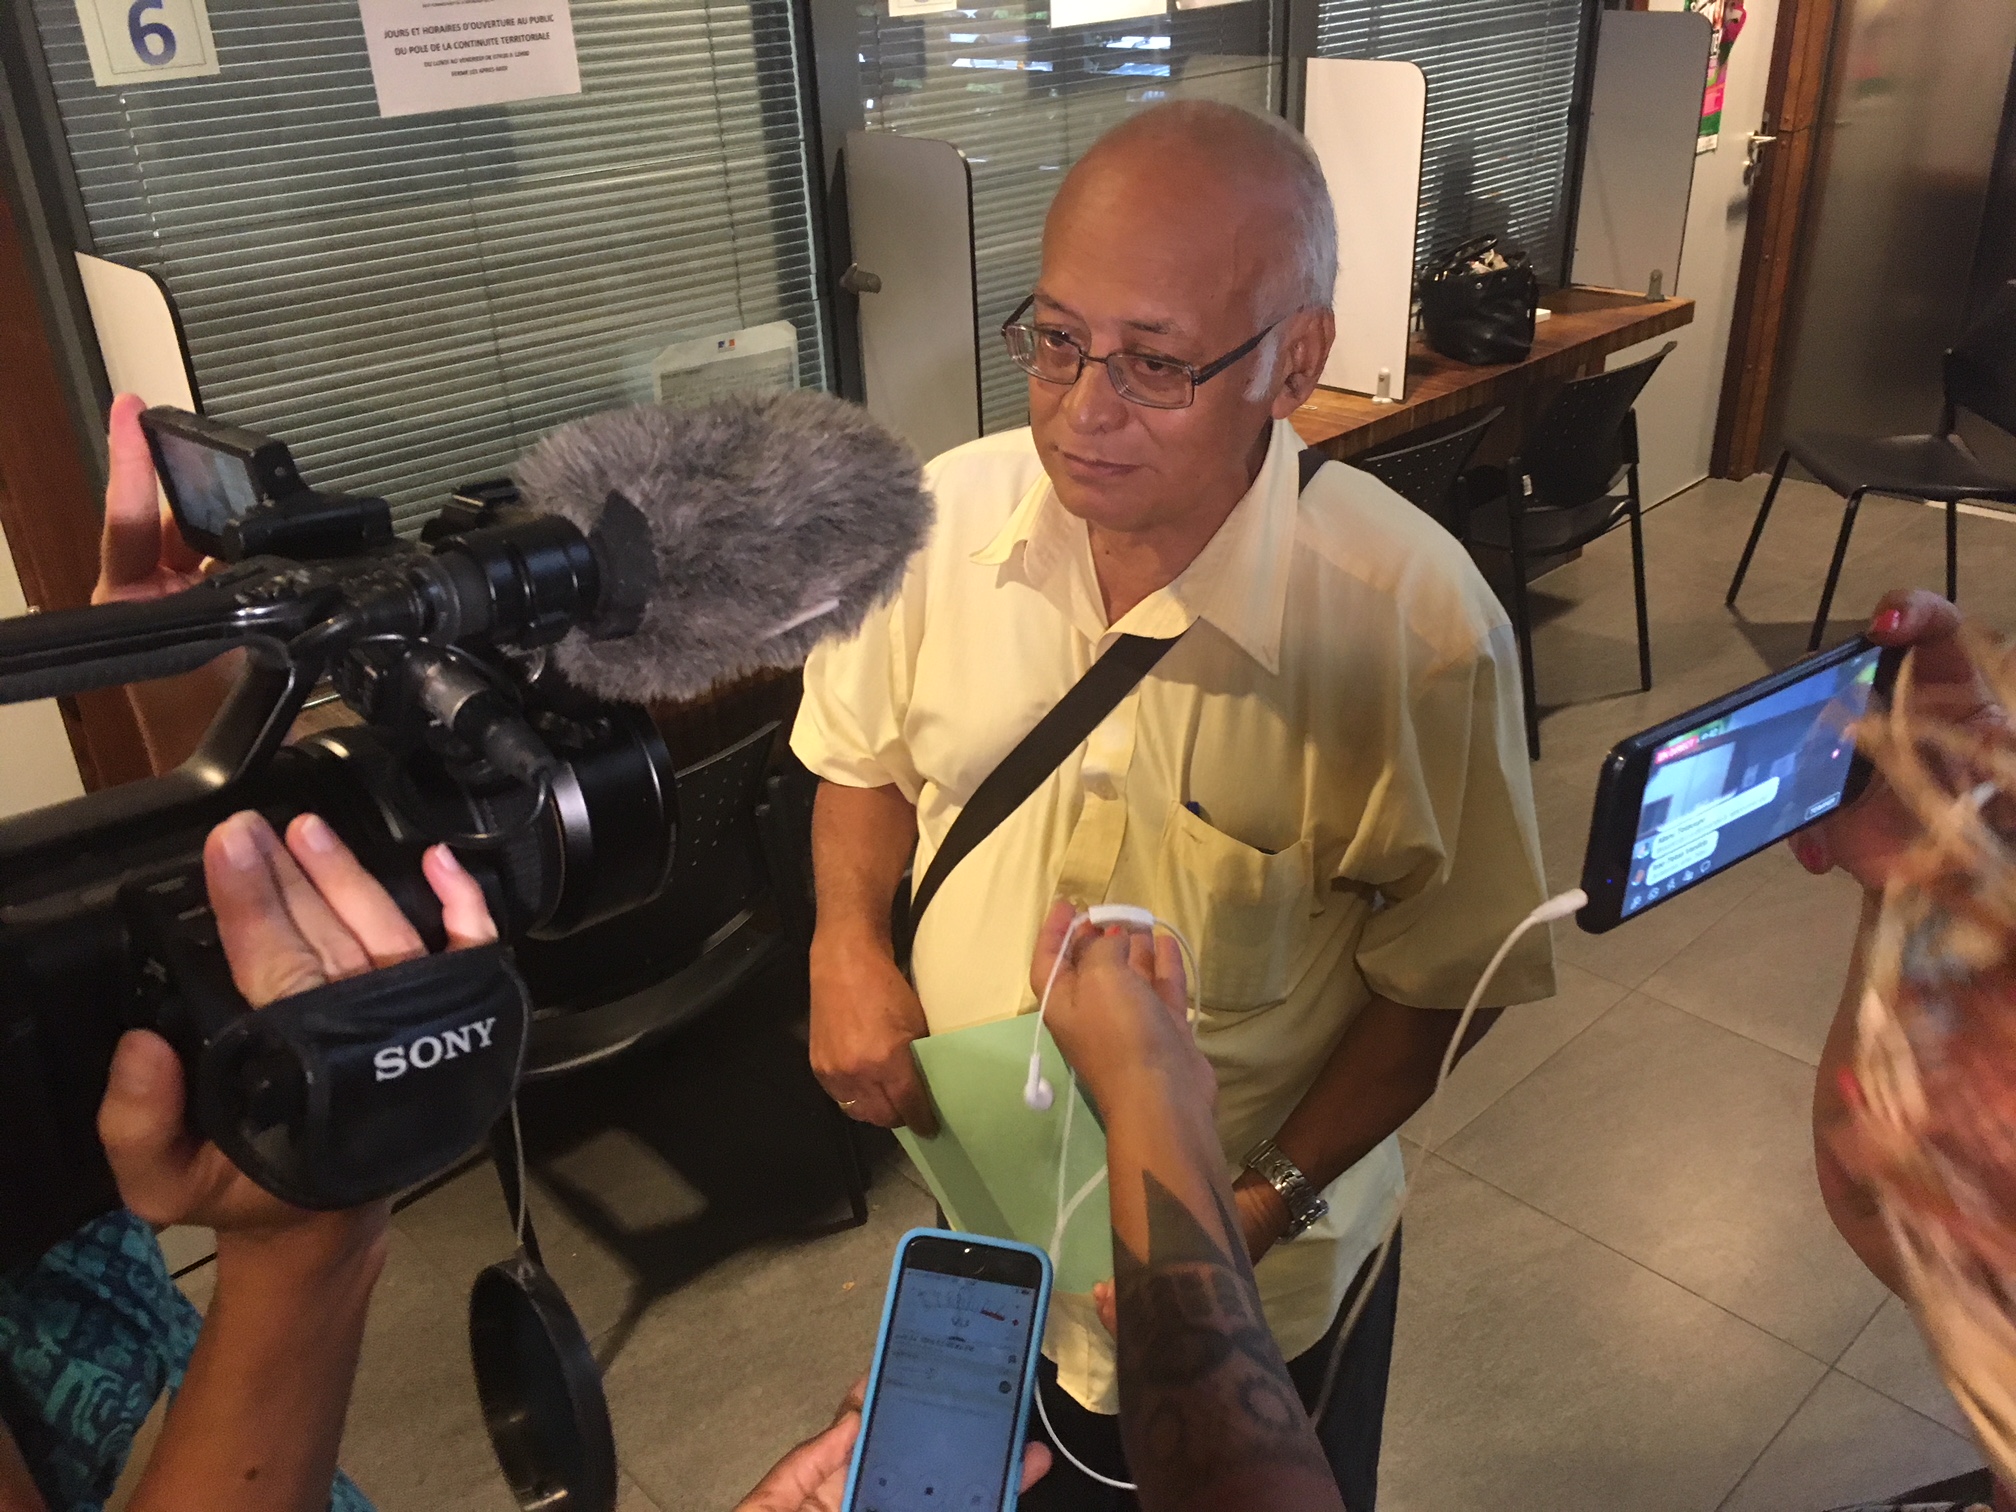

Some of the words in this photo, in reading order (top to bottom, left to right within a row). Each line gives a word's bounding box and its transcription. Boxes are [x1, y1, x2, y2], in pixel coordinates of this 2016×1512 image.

[128, 0, 177, 66] 6
[384, 28, 410, 39] JOURS
[411, 27, 420, 36] ET
[422, 23, 461, 35] HORAIRES
[462, 18, 516, 31] D'OUVERTURE
[517, 17, 528, 25] AU
[529, 14, 554, 24] PUBLIC
[395, 47, 408, 56] DU
[409, 45, 428, 54] POLE
[430, 43, 440, 52] DE
[442, 42, 452, 51] LA
[453, 37, 499, 49] CONTINUITE
[500, 32, 550, 44] TERRITORIALE
[373, 1016, 497, 1082] SONY
